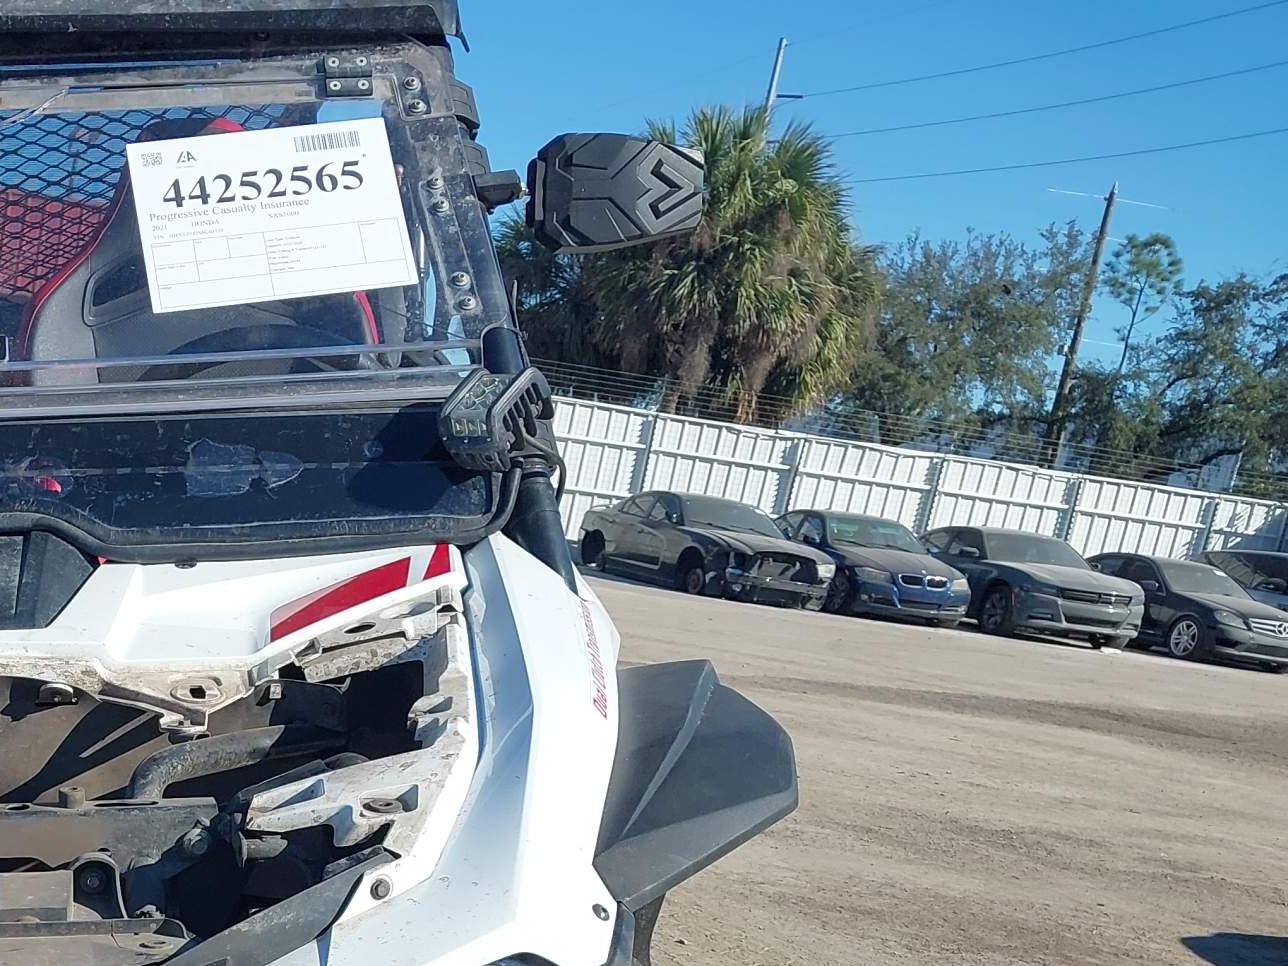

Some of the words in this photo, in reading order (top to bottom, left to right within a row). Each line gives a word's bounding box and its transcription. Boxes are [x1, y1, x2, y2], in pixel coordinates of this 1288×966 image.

[162, 160, 364, 208] 44252565
[149, 208, 209, 222] Progressive
[212, 203, 257, 216] Casualty
[260, 198, 310, 210] Insurance
